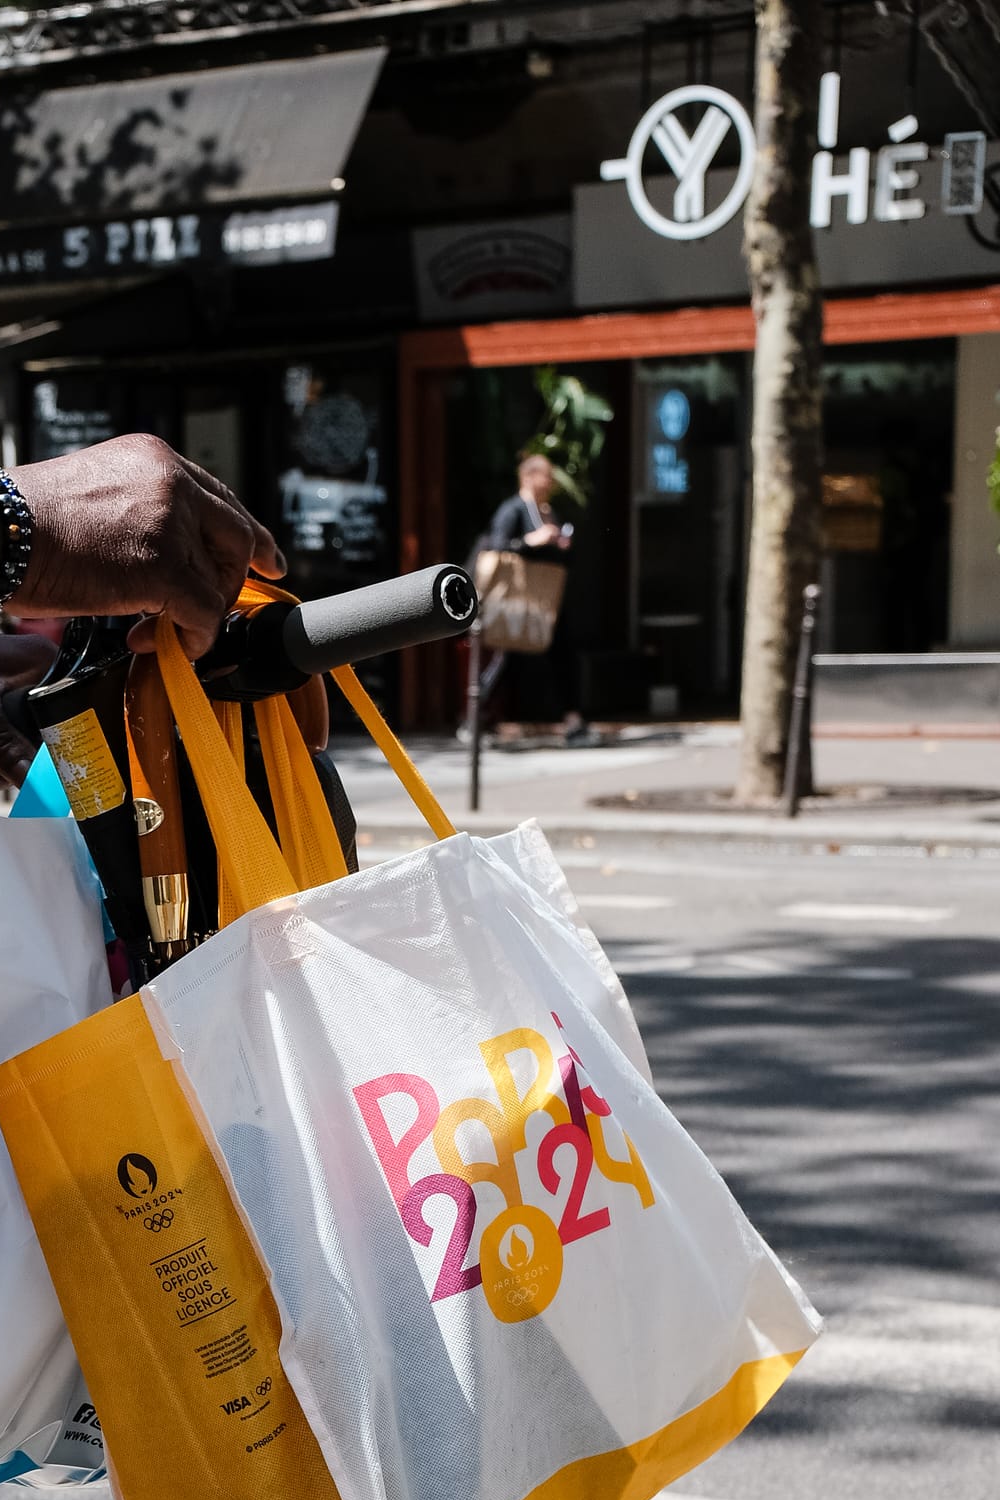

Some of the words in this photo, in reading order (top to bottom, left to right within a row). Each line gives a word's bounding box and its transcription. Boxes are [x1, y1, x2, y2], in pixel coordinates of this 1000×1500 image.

[809, 114, 929, 229] HÉ
[124, 1202, 152, 1220] PARIS
[153, 1188, 183, 1207] 2024
[155, 1245, 208, 1279] PRODUIT
[162, 1261, 219, 1293] OFFICIEL
[176, 1287, 231, 1321] LICENCE
[177, 1280, 213, 1303] SOUS
[220, 1396, 251, 1415] VISA
